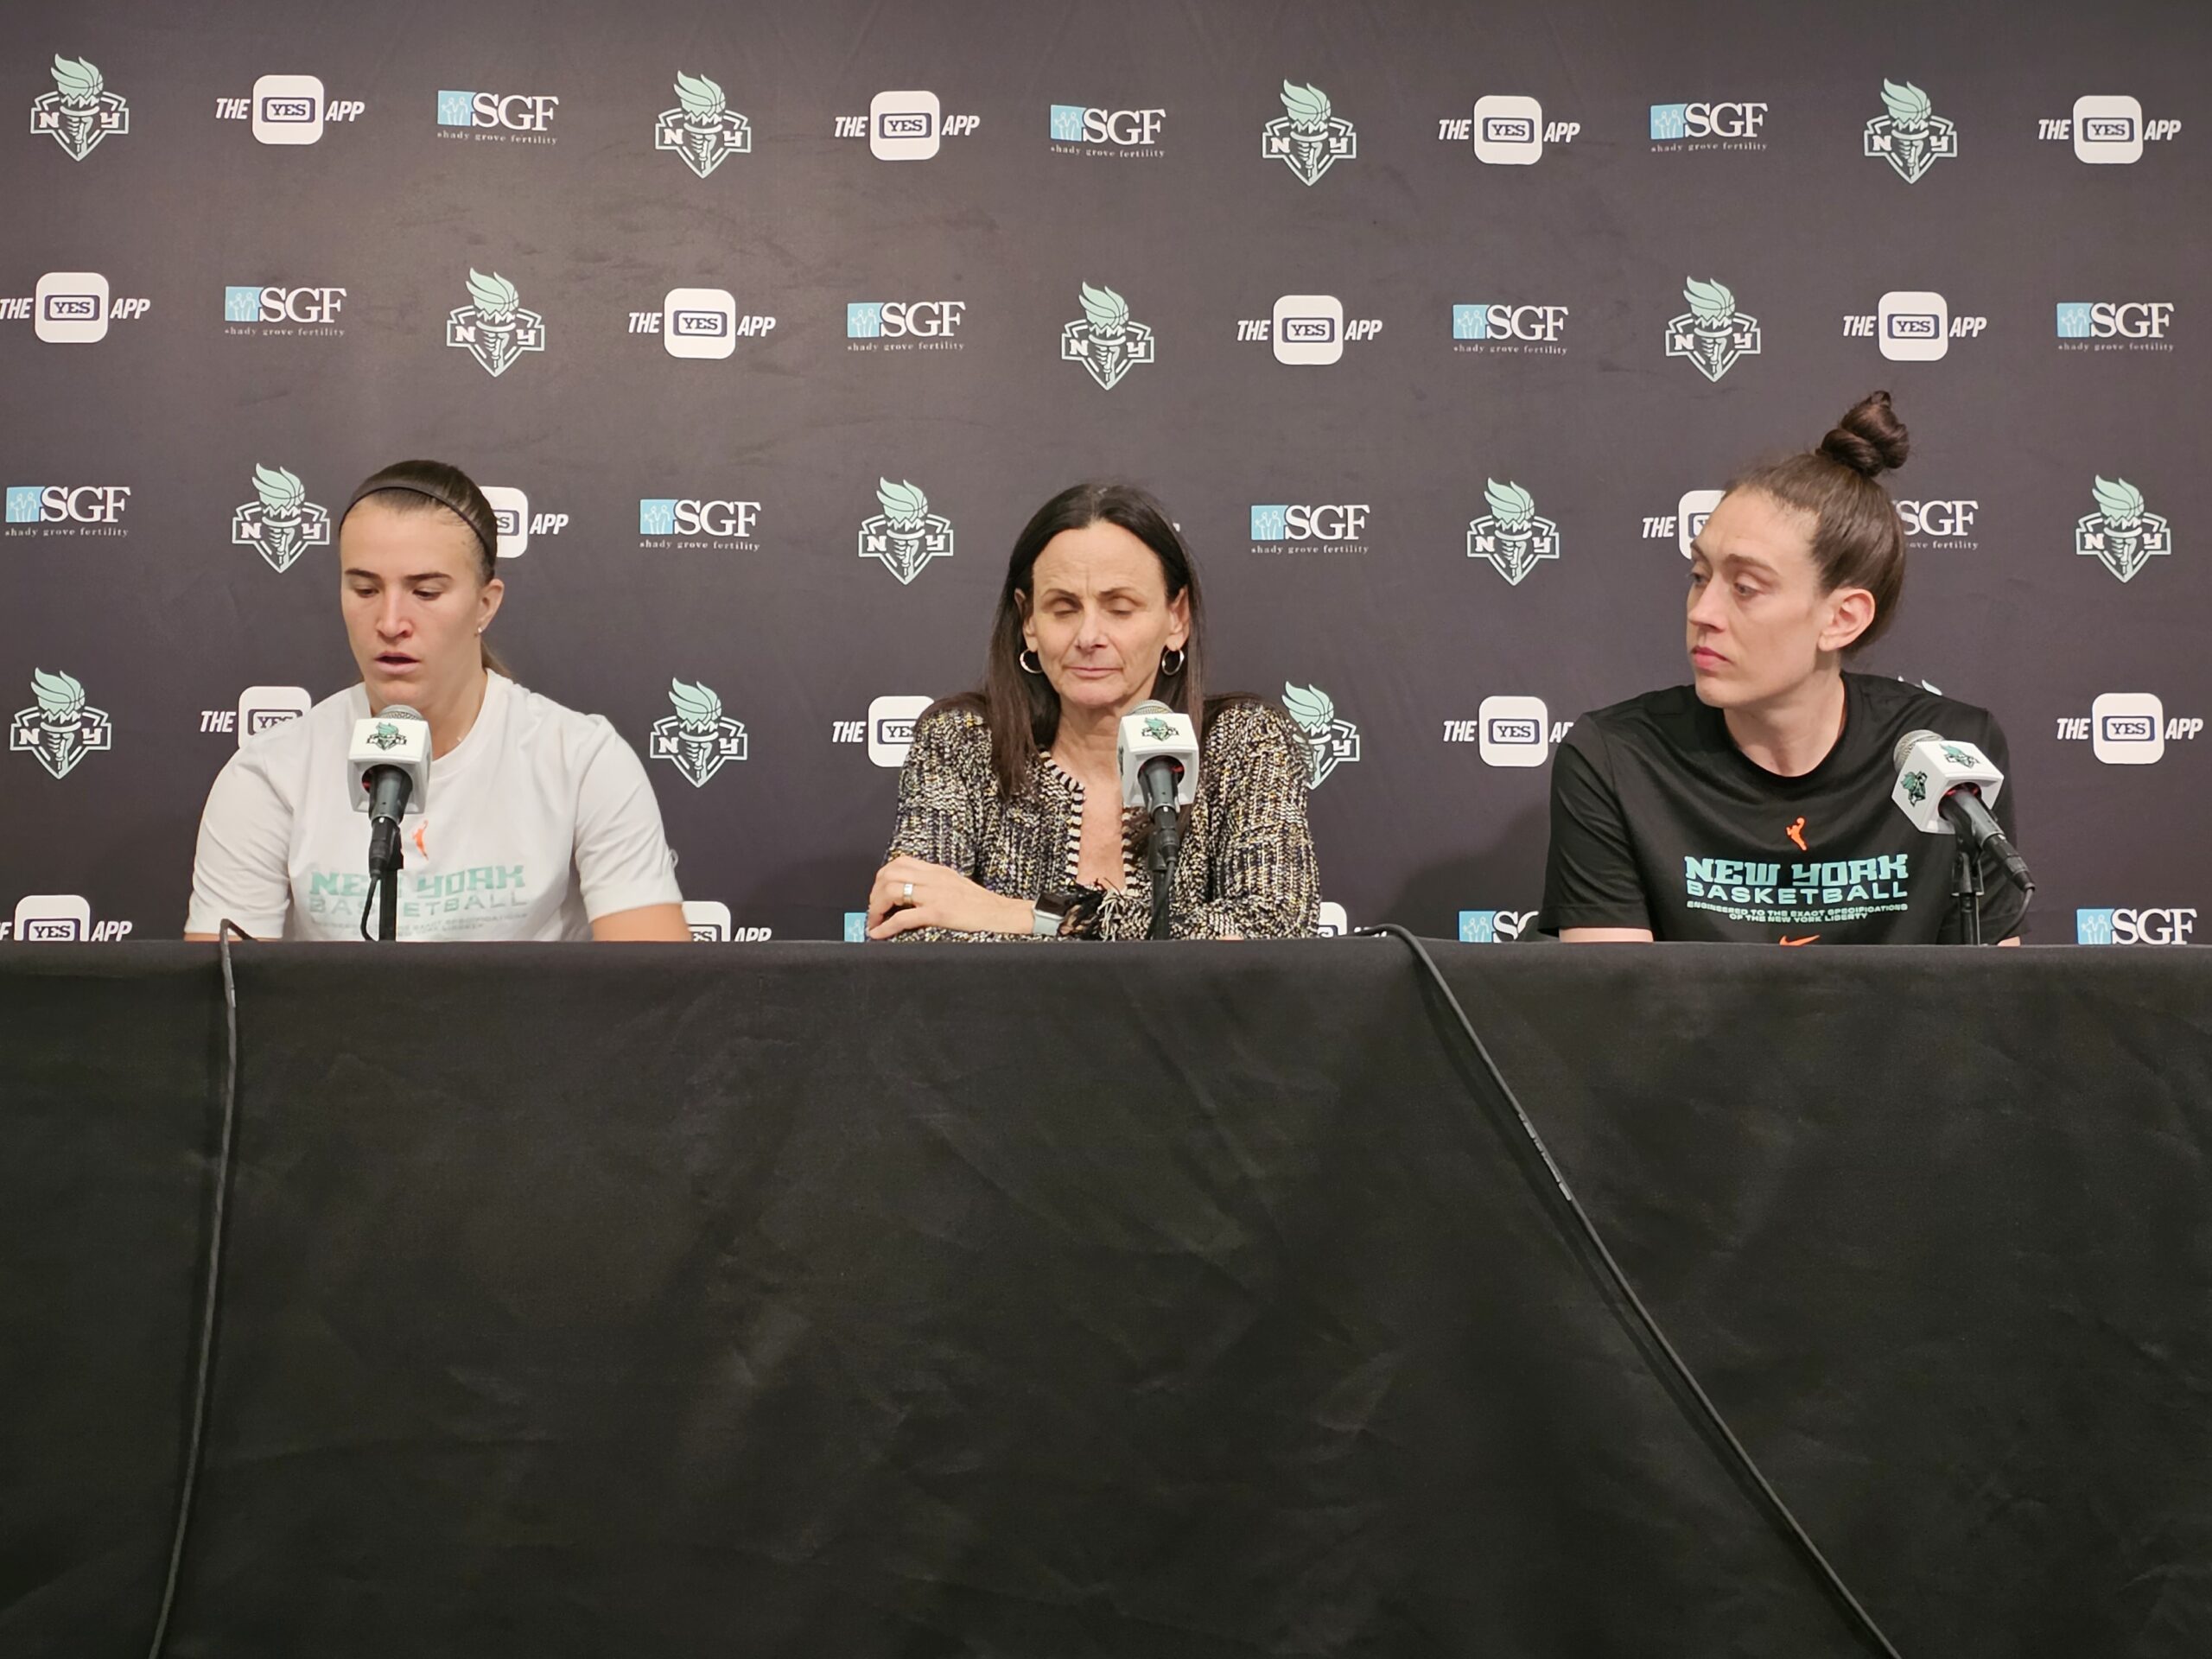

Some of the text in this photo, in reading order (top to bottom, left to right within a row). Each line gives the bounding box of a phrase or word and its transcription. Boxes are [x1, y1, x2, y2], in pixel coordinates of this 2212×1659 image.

[39, 111, 121, 129] N Y
[215, 98, 365, 122] THE YES APP
[473, 92, 558, 131] SGF
[1684, 102, 1769, 138] SGF
[834, 115, 981, 137] THE YES APP
[1083, 108, 1166, 145] SGF
[1438, 119, 1580, 143] THE YES APP
[2038, 119, 2182, 141] THE YES APP
[436, 130, 557, 146] shady grove fertility
[664, 128, 743, 148] N Y
[1270, 137, 1349, 154] N Y
[1650, 141, 1768, 154] shady grove fertility
[1872, 135, 1949, 152] N Y
[1050, 146, 1166, 160] shady grove fertility
[0, 298, 151, 320] THE YES APP
[258, 286, 347, 323] SGF
[628, 312, 777, 337] THE YES APP
[880, 301, 966, 338] SGF
[1236, 320, 1383, 341] THE YES APP
[1486, 304, 1569, 341] SGF
[1843, 315, 1987, 338] THE YES APP
[2090, 302, 2174, 338] SGF
[224, 326, 346, 340] shady grove fertility
[454, 325, 537, 346] N Y
[1674, 333, 1753, 351] N Y
[847, 340, 964, 354] shady grove fertility
[1069, 339, 1147, 358] N Y
[1452, 343, 1568, 357] shady grove fertility
[2057, 341, 2174, 354] shady grove fertility
[40, 486, 131, 523] SGF
[529, 513, 569, 535] APP
[674, 499, 762, 537] SGF
[1284, 504, 1370, 540] SGF
[1642, 516, 1678, 538] THE
[1896, 500, 1979, 537] SGF
[4, 526, 130, 540] shady grove fertility
[240, 522, 322, 540] N Y
[2083, 532, 2163, 550] N Y
[639, 538, 760, 553] shady grove fertility
[867, 534, 946, 552] N Y
[1250, 543, 1370, 557] shady grove fertility
[1475, 536, 1552, 554] N Y
[1930, 541, 1979, 551] fertility
[200, 710, 237, 733] THE
[832, 721, 914, 743] THE YE
[1443, 720, 1478, 742] THE
[1497, 724, 1531, 739] YES
[2056, 717, 2203, 740] THE YES APP
[18, 728, 103, 745] N Y
[658, 736, 740, 754] N Y
[1332, 739, 1352, 757] Y
[1684, 854, 1909, 887] NEW YORK
[416, 865, 525, 899] YORK
[1686, 880, 1909, 906] BASKETBALL
[308, 893, 528, 918] BASETBALL
[1687, 900, 1748, 915] ENGINEERED
[1789, 909, 1825, 918] EXACT
[1827, 903, 1909, 916] SPECIFICATIONS
[1825, 912, 1868, 922] LIBERTY
[2111, 908, 2197, 945] SGF
[34, 920, 133, 942] YES APP
